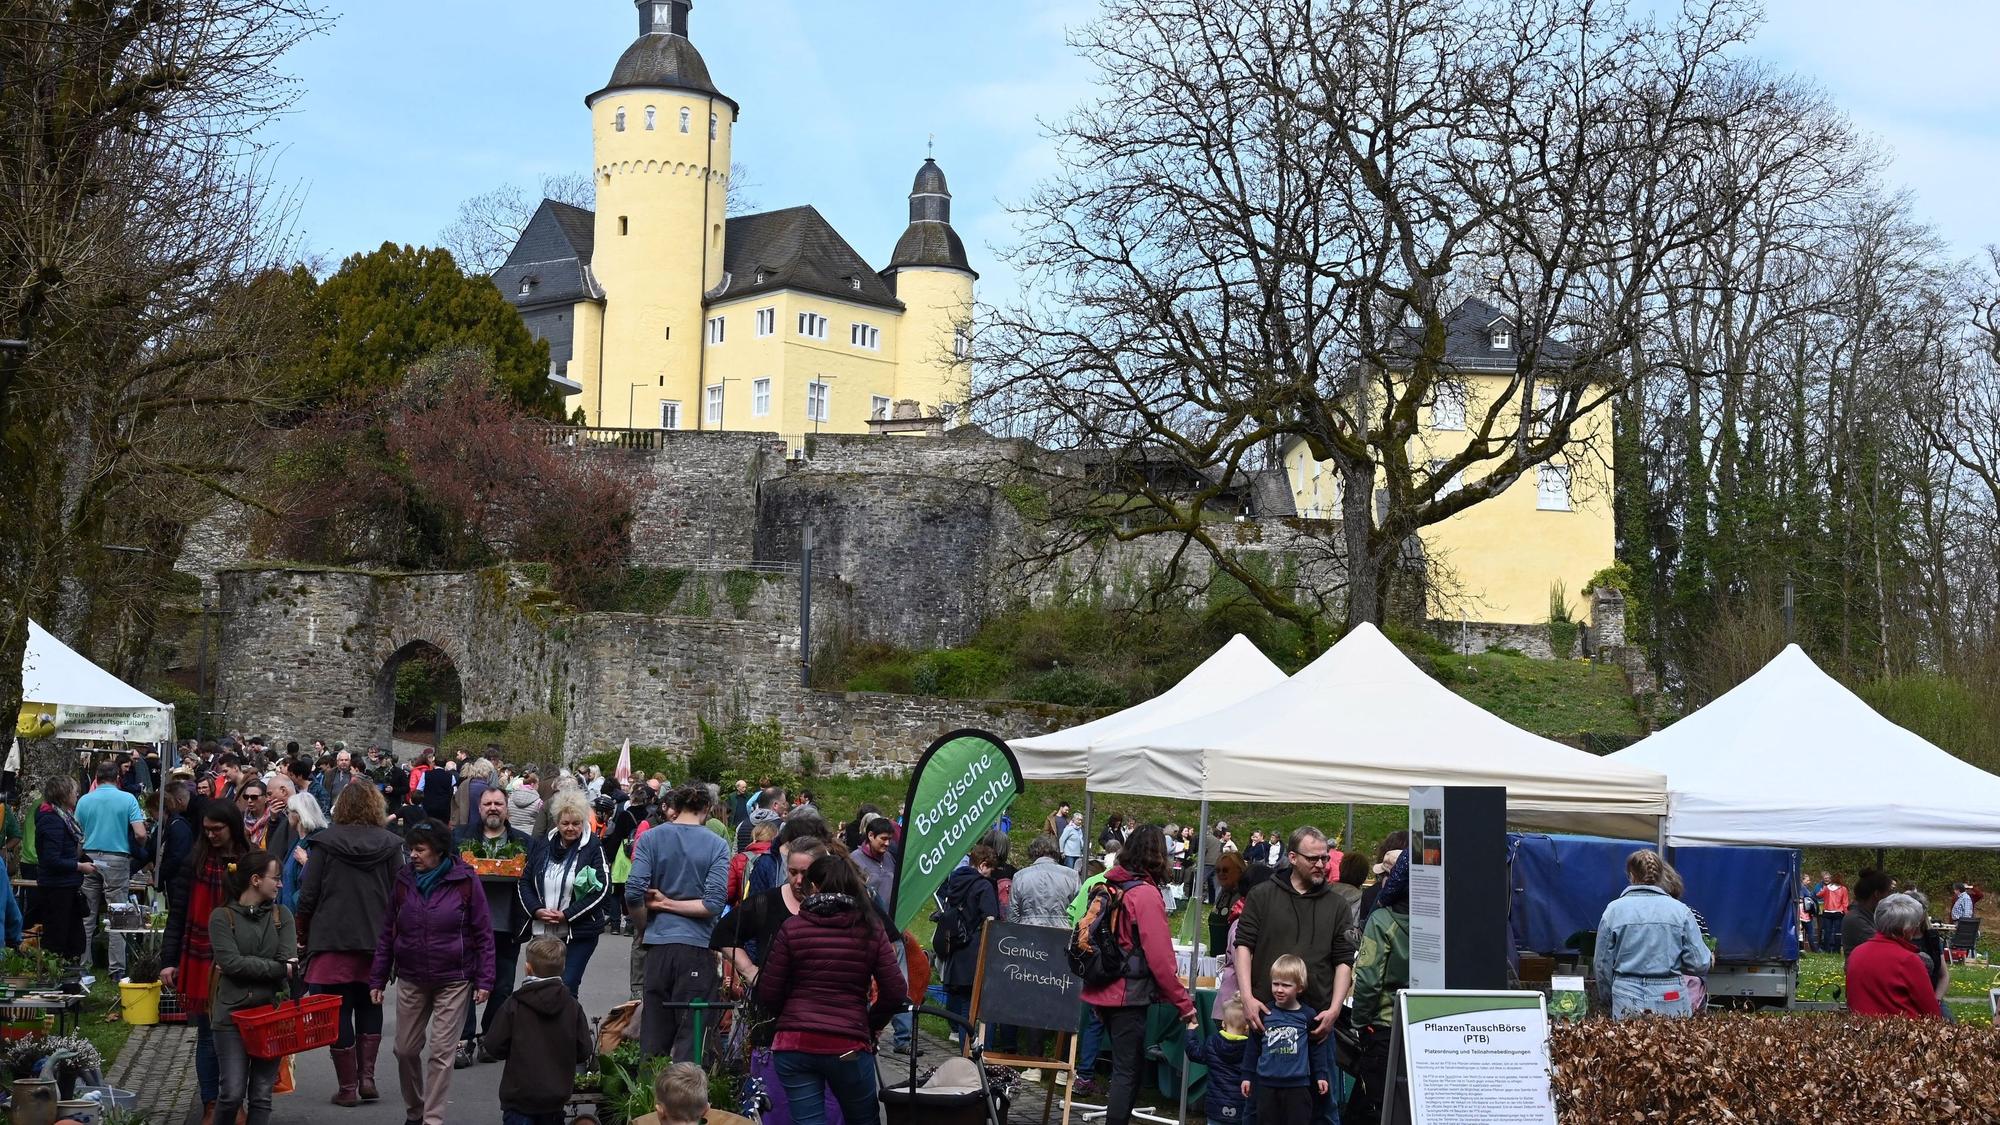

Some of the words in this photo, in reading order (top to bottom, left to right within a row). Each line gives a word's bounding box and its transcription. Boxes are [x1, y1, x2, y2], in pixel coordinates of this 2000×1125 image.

[78, 719, 150, 727] Landschaftsgestaltung
[915, 754, 992, 836] Bergische
[919, 772, 1012, 875] Gartenarche
[998, 936, 1049, 961] Gemüse
[1003, 964, 1073, 995] Patenschaft
[1424, 1023, 1527, 1033] PflanzenTauschBörse
[1463, 1034, 1490, 1044] (PTB)
